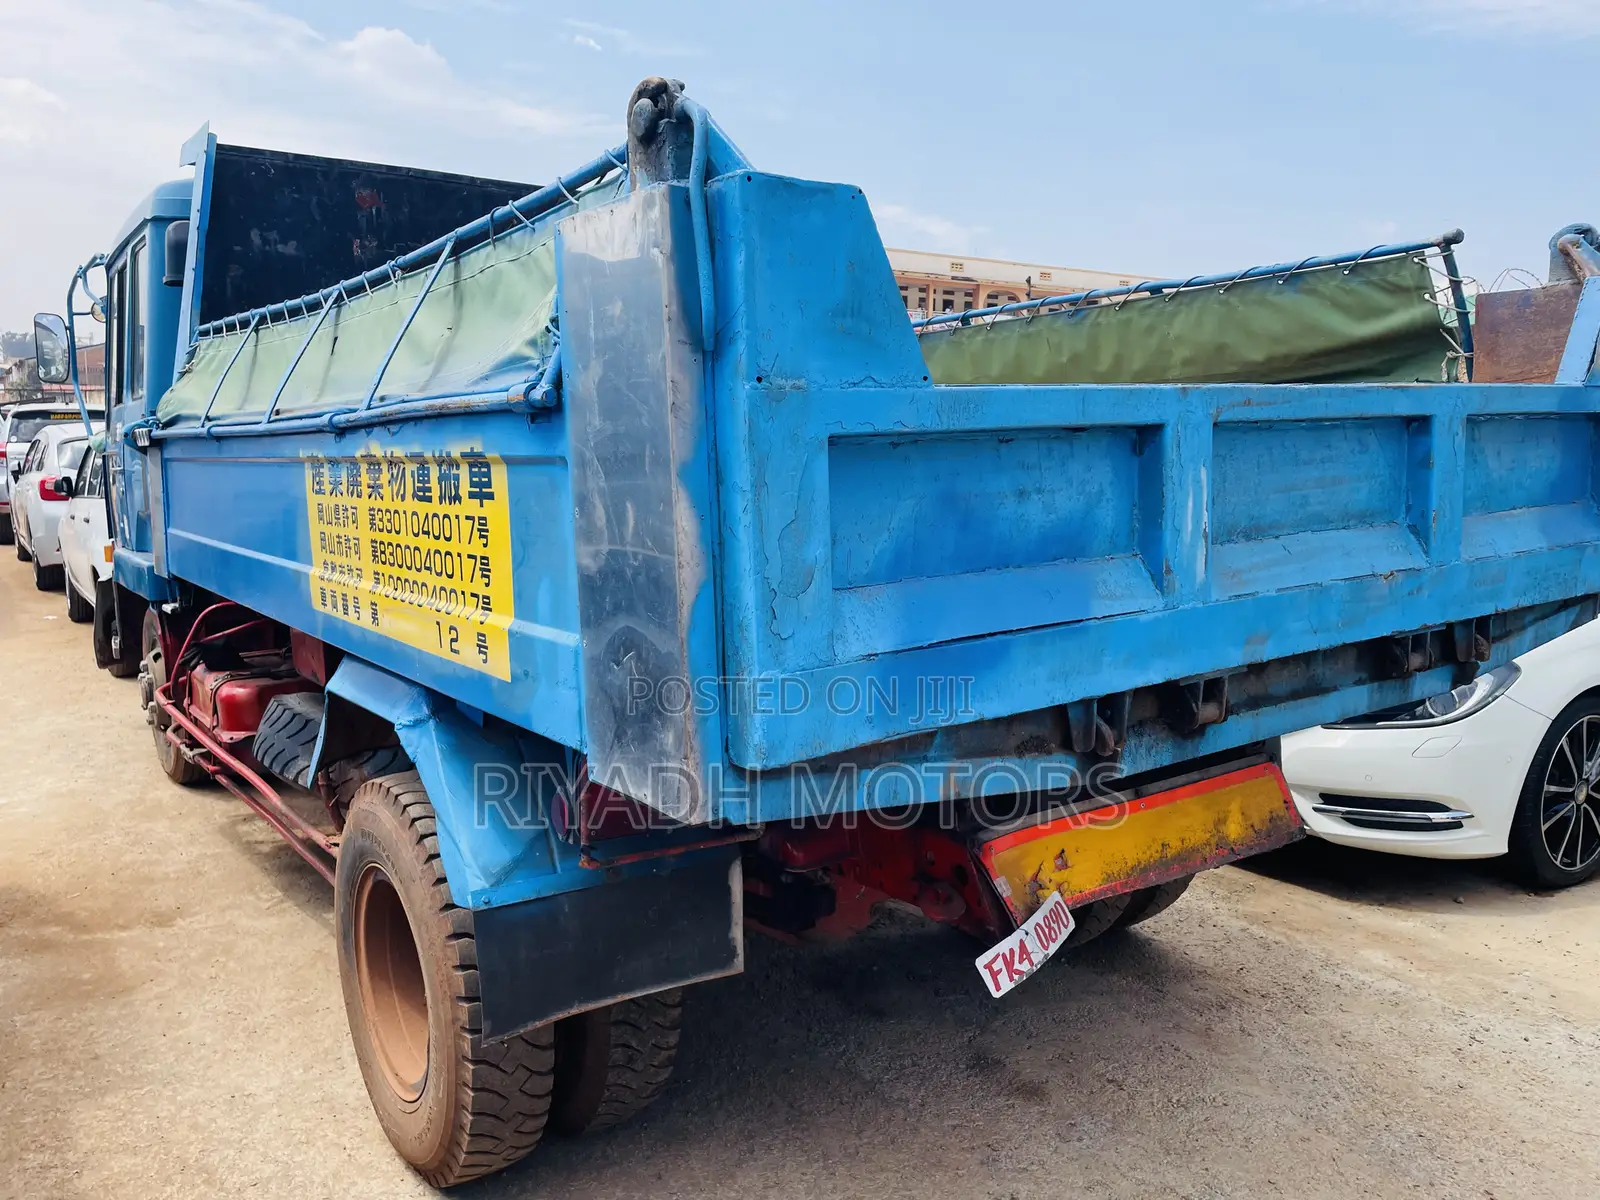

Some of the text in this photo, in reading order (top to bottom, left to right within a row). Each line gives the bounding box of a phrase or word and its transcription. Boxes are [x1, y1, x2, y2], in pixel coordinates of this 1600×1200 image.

[368, 506, 490, 548] 第3301040017号
[370, 538, 492, 588] 第8300040017号
[435, 620, 461, 655] 12
[476, 631, 489, 664] 号
[1033, 900, 1070, 951] 0890
